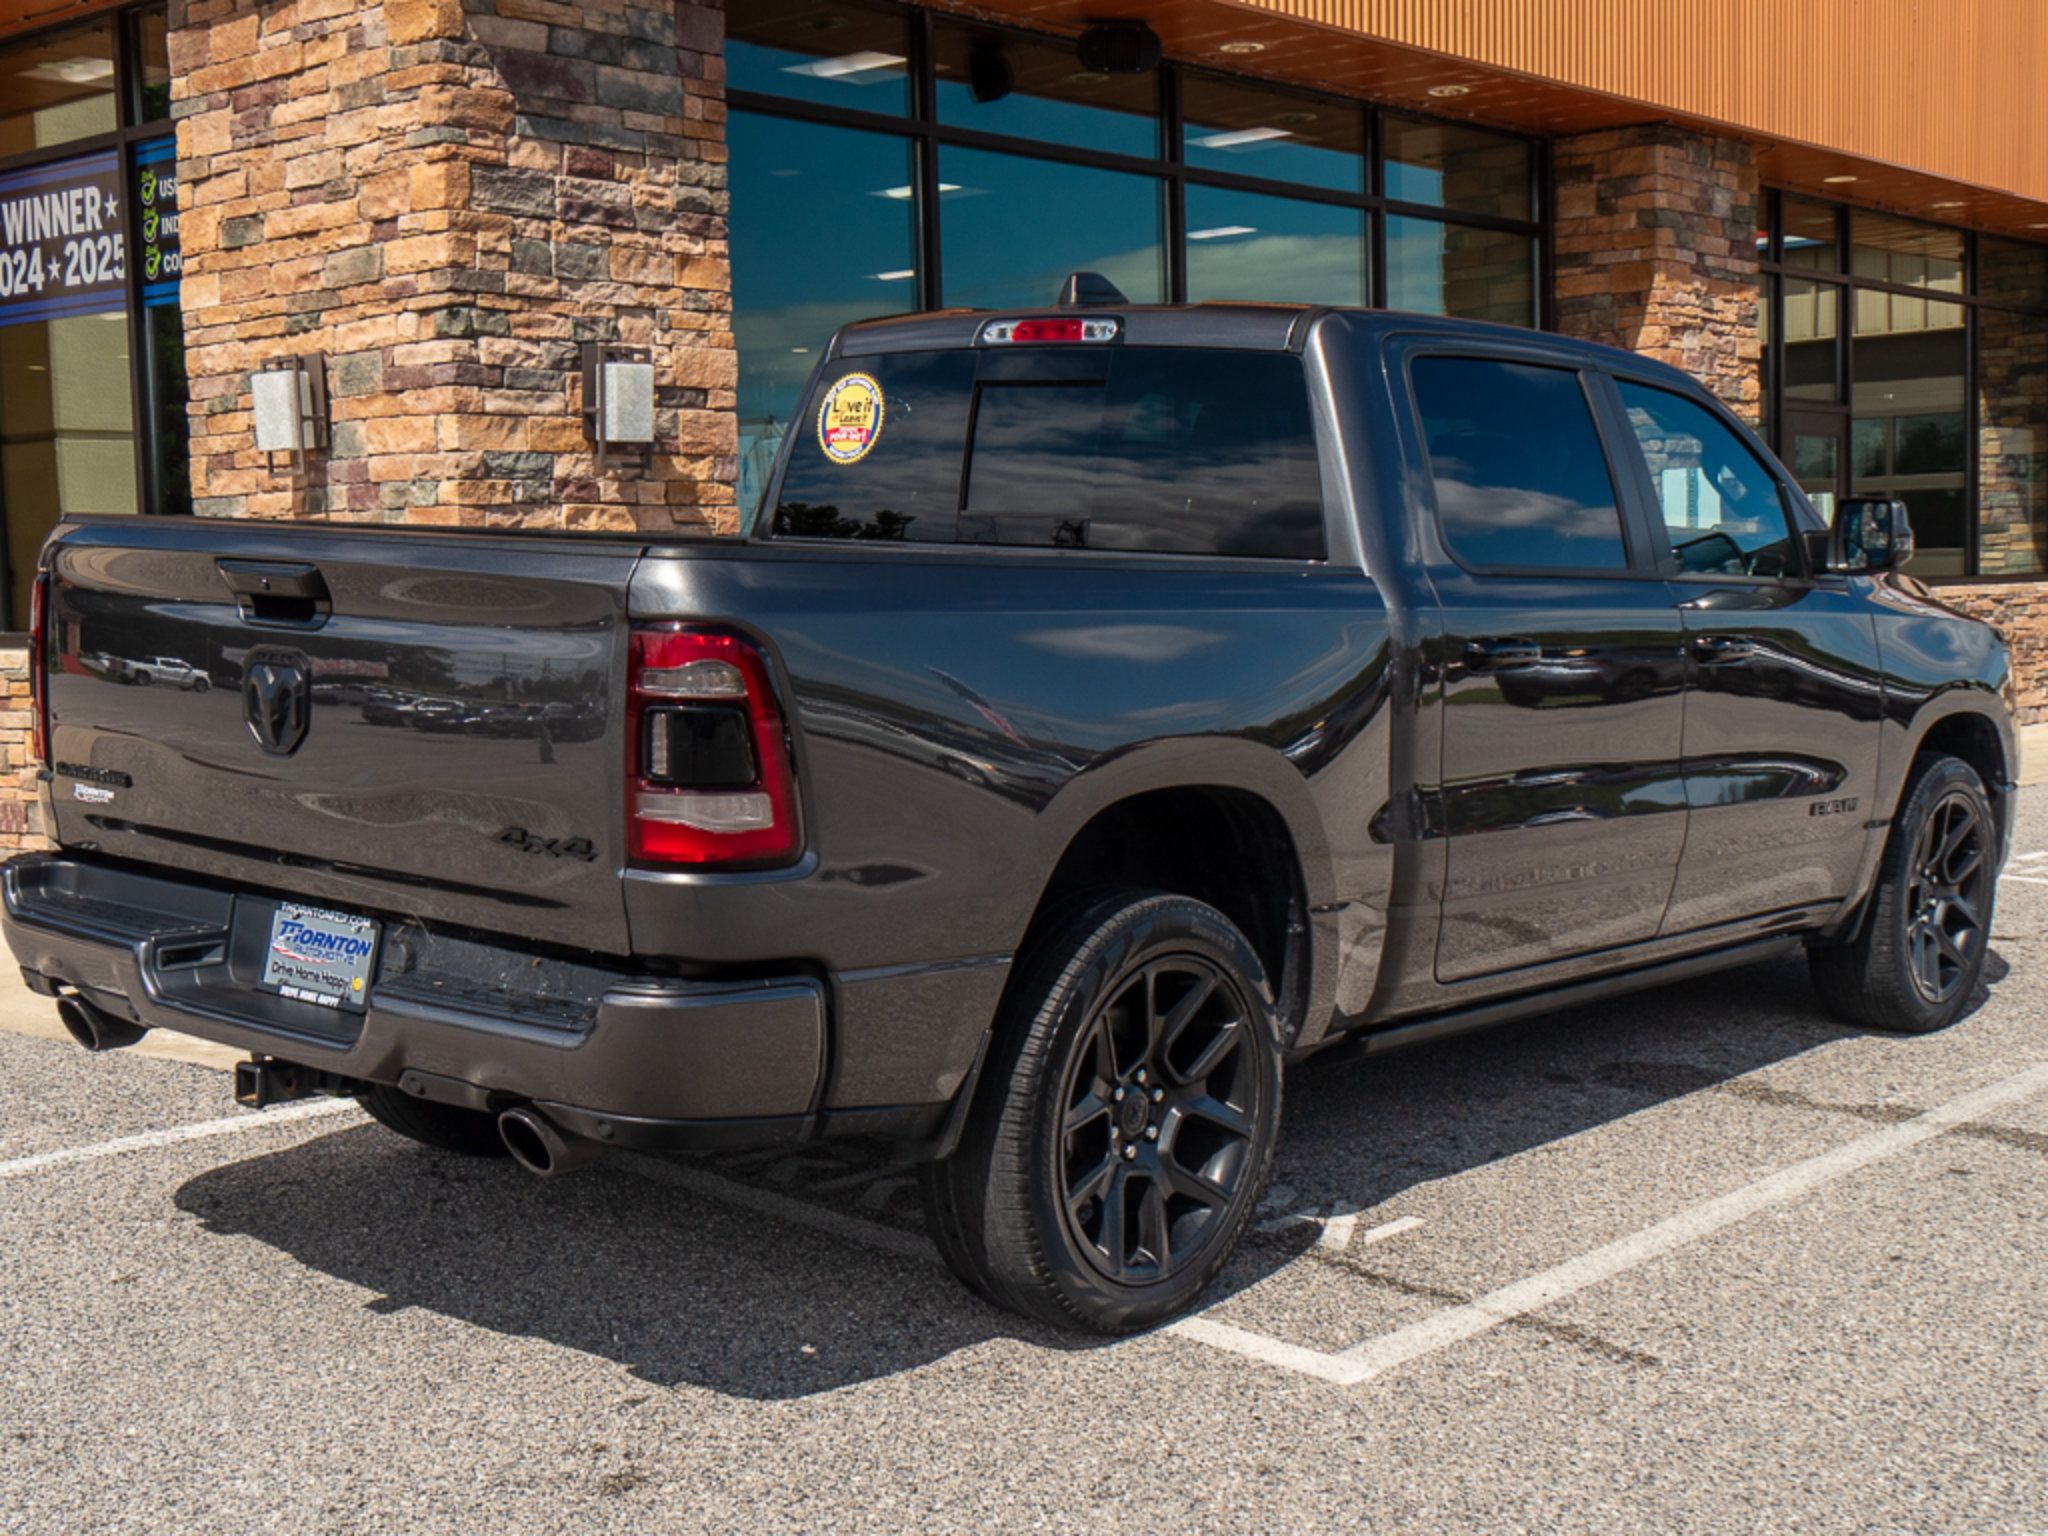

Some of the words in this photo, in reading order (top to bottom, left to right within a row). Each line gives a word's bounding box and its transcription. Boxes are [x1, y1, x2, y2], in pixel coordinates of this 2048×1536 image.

[159, 178, 177, 197] US
[2, 186, 102, 245] WINNER
[64, 233, 125, 286] 2025
[280, 920, 372, 957] THORNTON
[272, 961, 294, 977] Drive
[295, 965, 320, 982] Home
